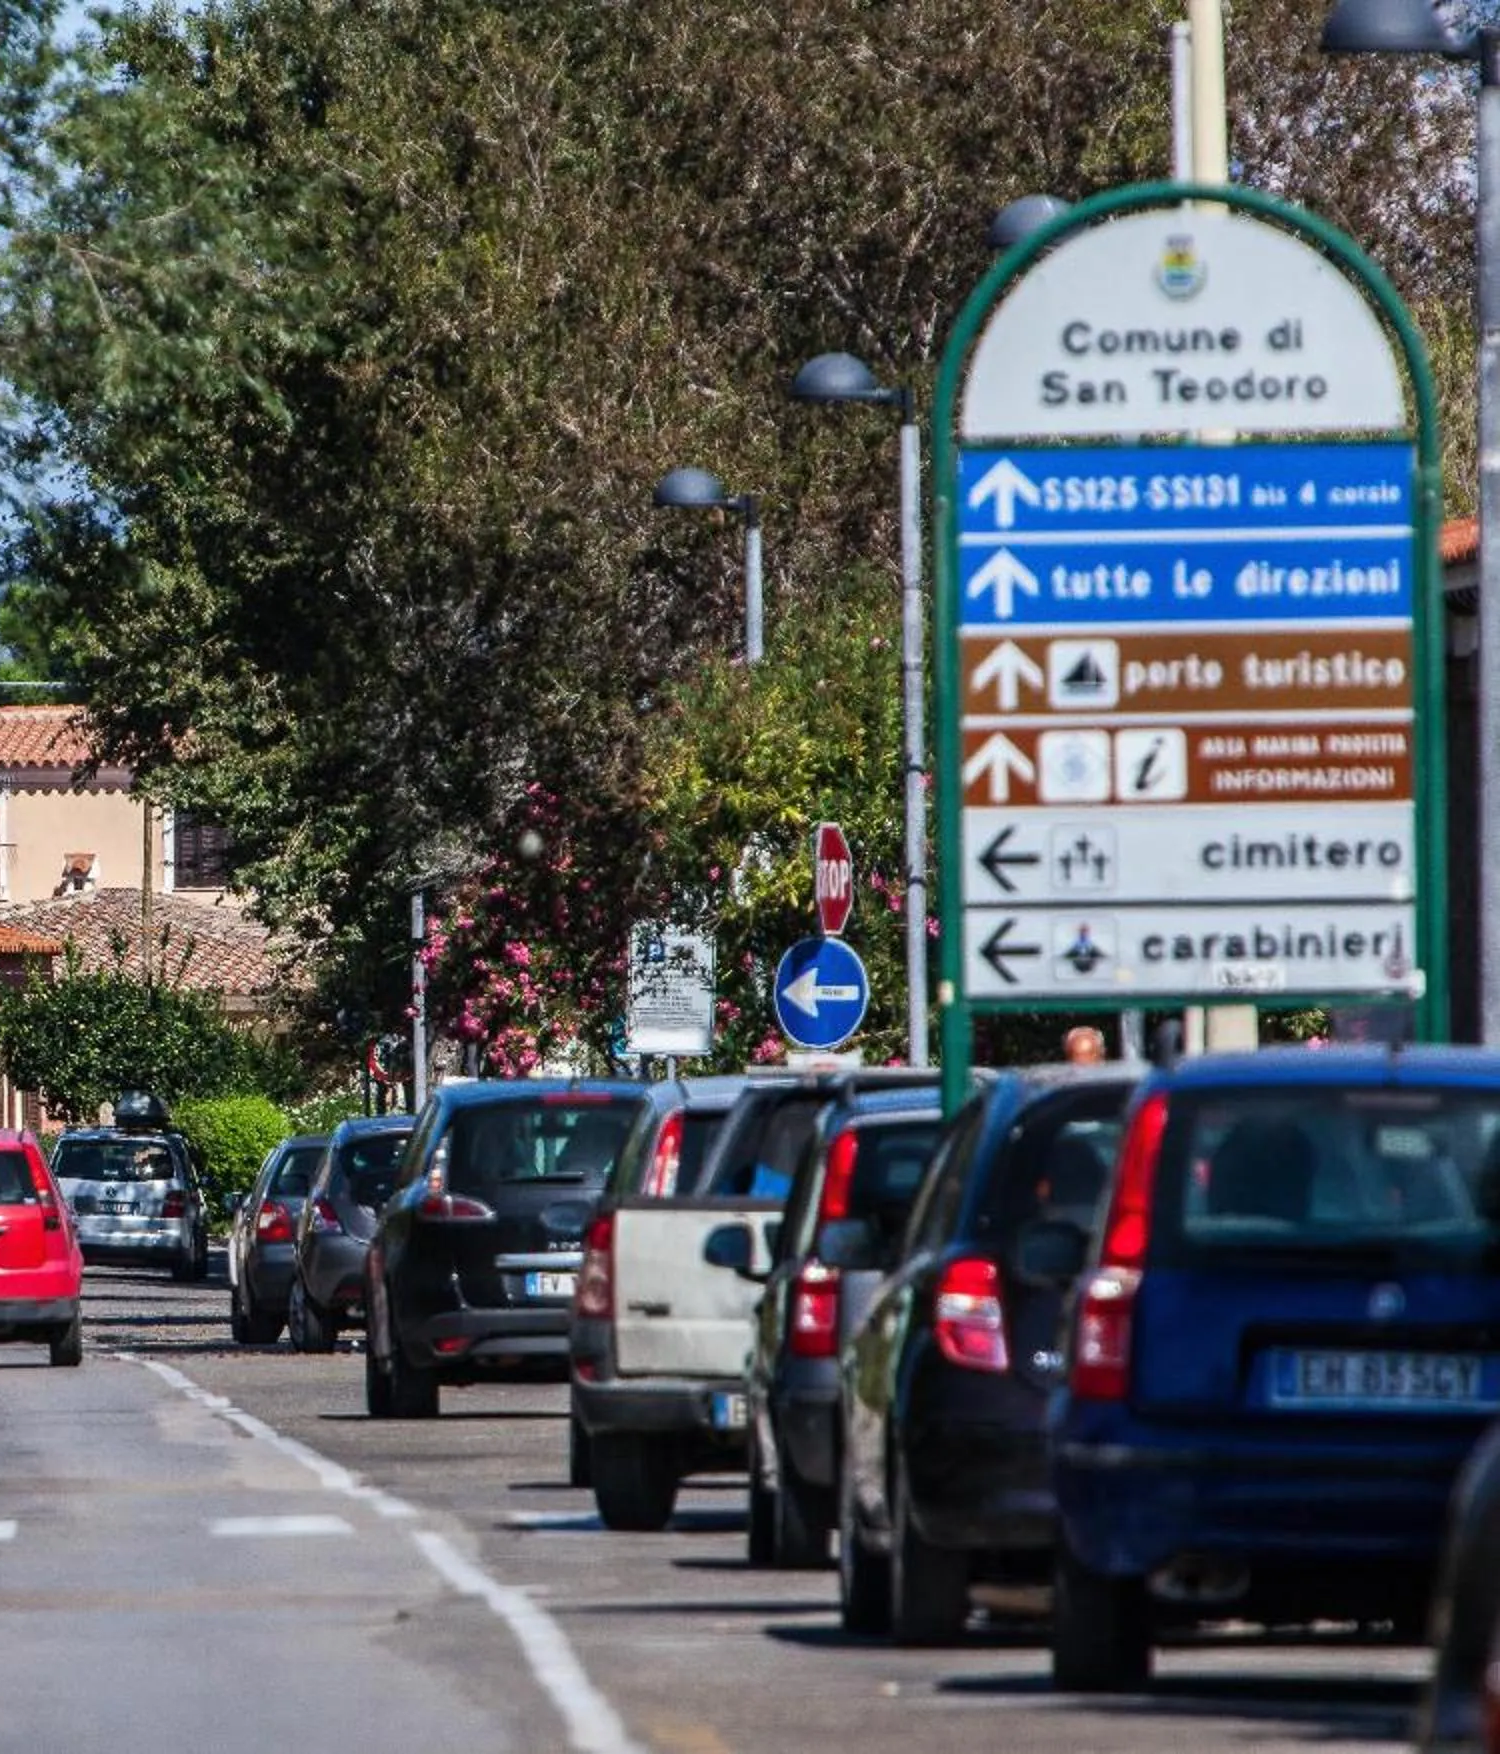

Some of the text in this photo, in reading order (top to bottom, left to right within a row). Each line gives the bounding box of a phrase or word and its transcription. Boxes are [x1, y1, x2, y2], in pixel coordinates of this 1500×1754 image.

[1061, 318, 1304, 357] Comune di
[1040, 368, 1330, 406] San Teodoro
[1251, 483, 1287, 506] bis
[1300, 480, 1316, 505] 4
[1328, 480, 1401, 504] corsie
[1051, 557, 1402, 600] tutte le direzioni
[1124, 650, 1406, 696] porto turistico
[1252, 734, 1320, 757] MARINA
[1213, 766, 1396, 792] INFORMAZIONI
[1200, 832, 1403, 870] cimitero
[1141, 922, 1404, 962] carabinieri
